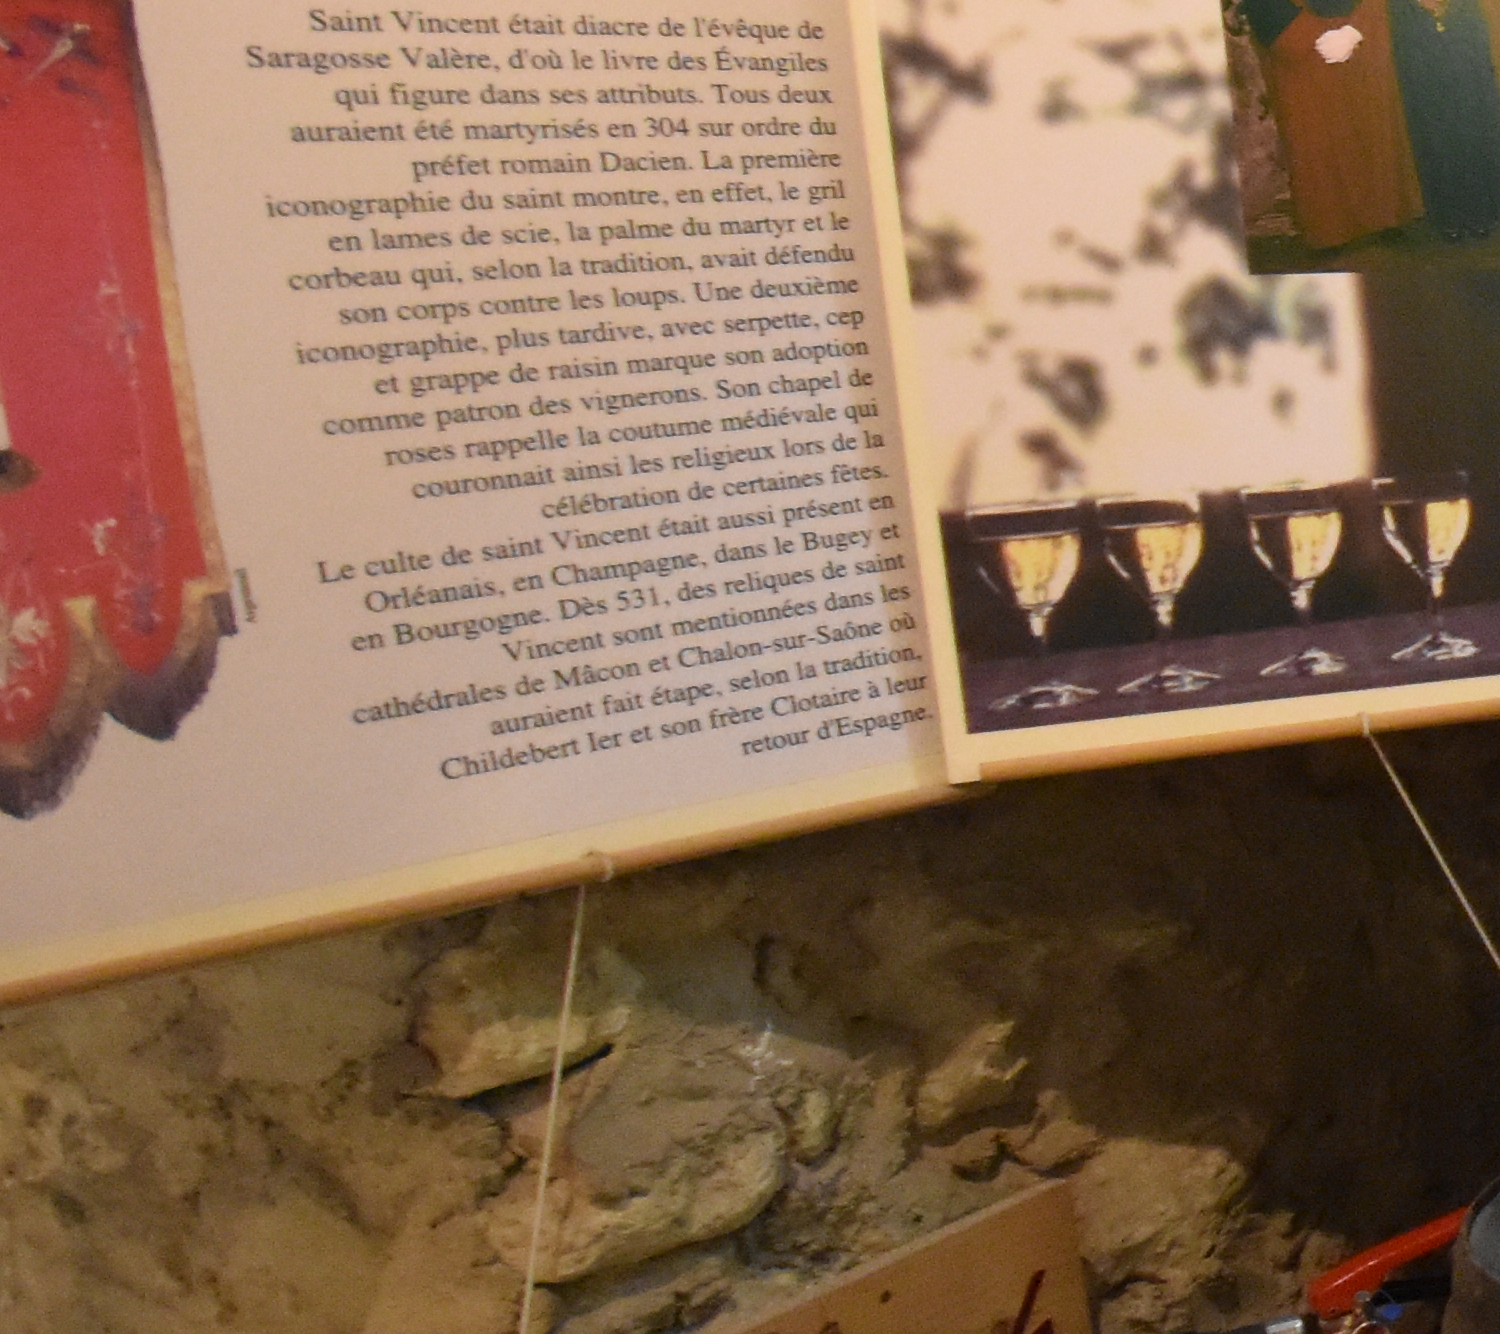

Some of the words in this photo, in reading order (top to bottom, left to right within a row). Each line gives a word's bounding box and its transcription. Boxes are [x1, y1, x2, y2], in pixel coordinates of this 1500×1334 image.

[308, 8, 383, 32] Saint
[389, 9, 500, 34] Vincent
[507, 13, 565, 35] était
[572, 14, 649, 37] diacre
[657, 15, 685, 37] de
[693, 16, 789, 45] l'évêque
[797, 20, 823, 40] de
[245, 45, 390, 75] Saragosse
[398, 45, 500, 71] Valère,
[507, 47, 564, 70] d'où
[569, 48, 593, 70] le
[600, 48, 658, 70] livre
[666, 49, 707, 71] des
[713, 45, 828, 77] Évangiles
[740, 728, 810, 755] retour
[816, 706, 933, 740] d'Espagne.
